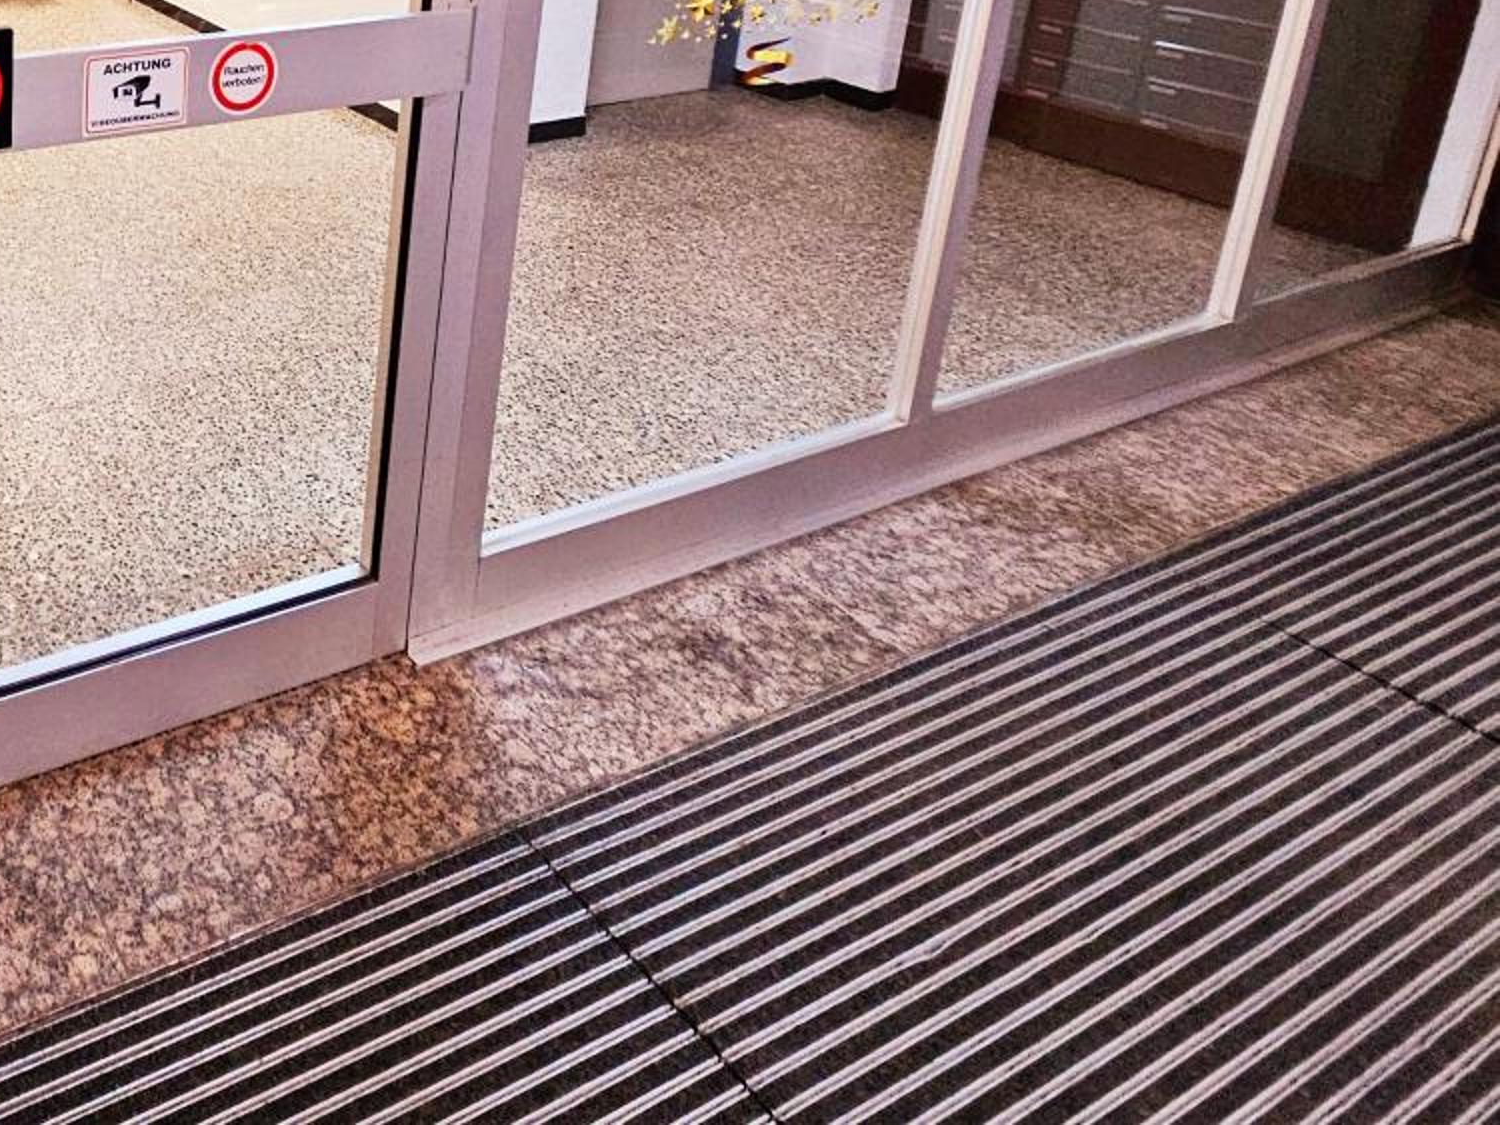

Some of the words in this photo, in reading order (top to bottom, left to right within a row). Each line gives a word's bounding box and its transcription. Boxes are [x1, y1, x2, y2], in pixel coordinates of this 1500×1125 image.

[103, 58, 171, 76] ACHTUNG
[224, 63, 265, 76] Rauchen
[222, 75, 263, 89] verboten
